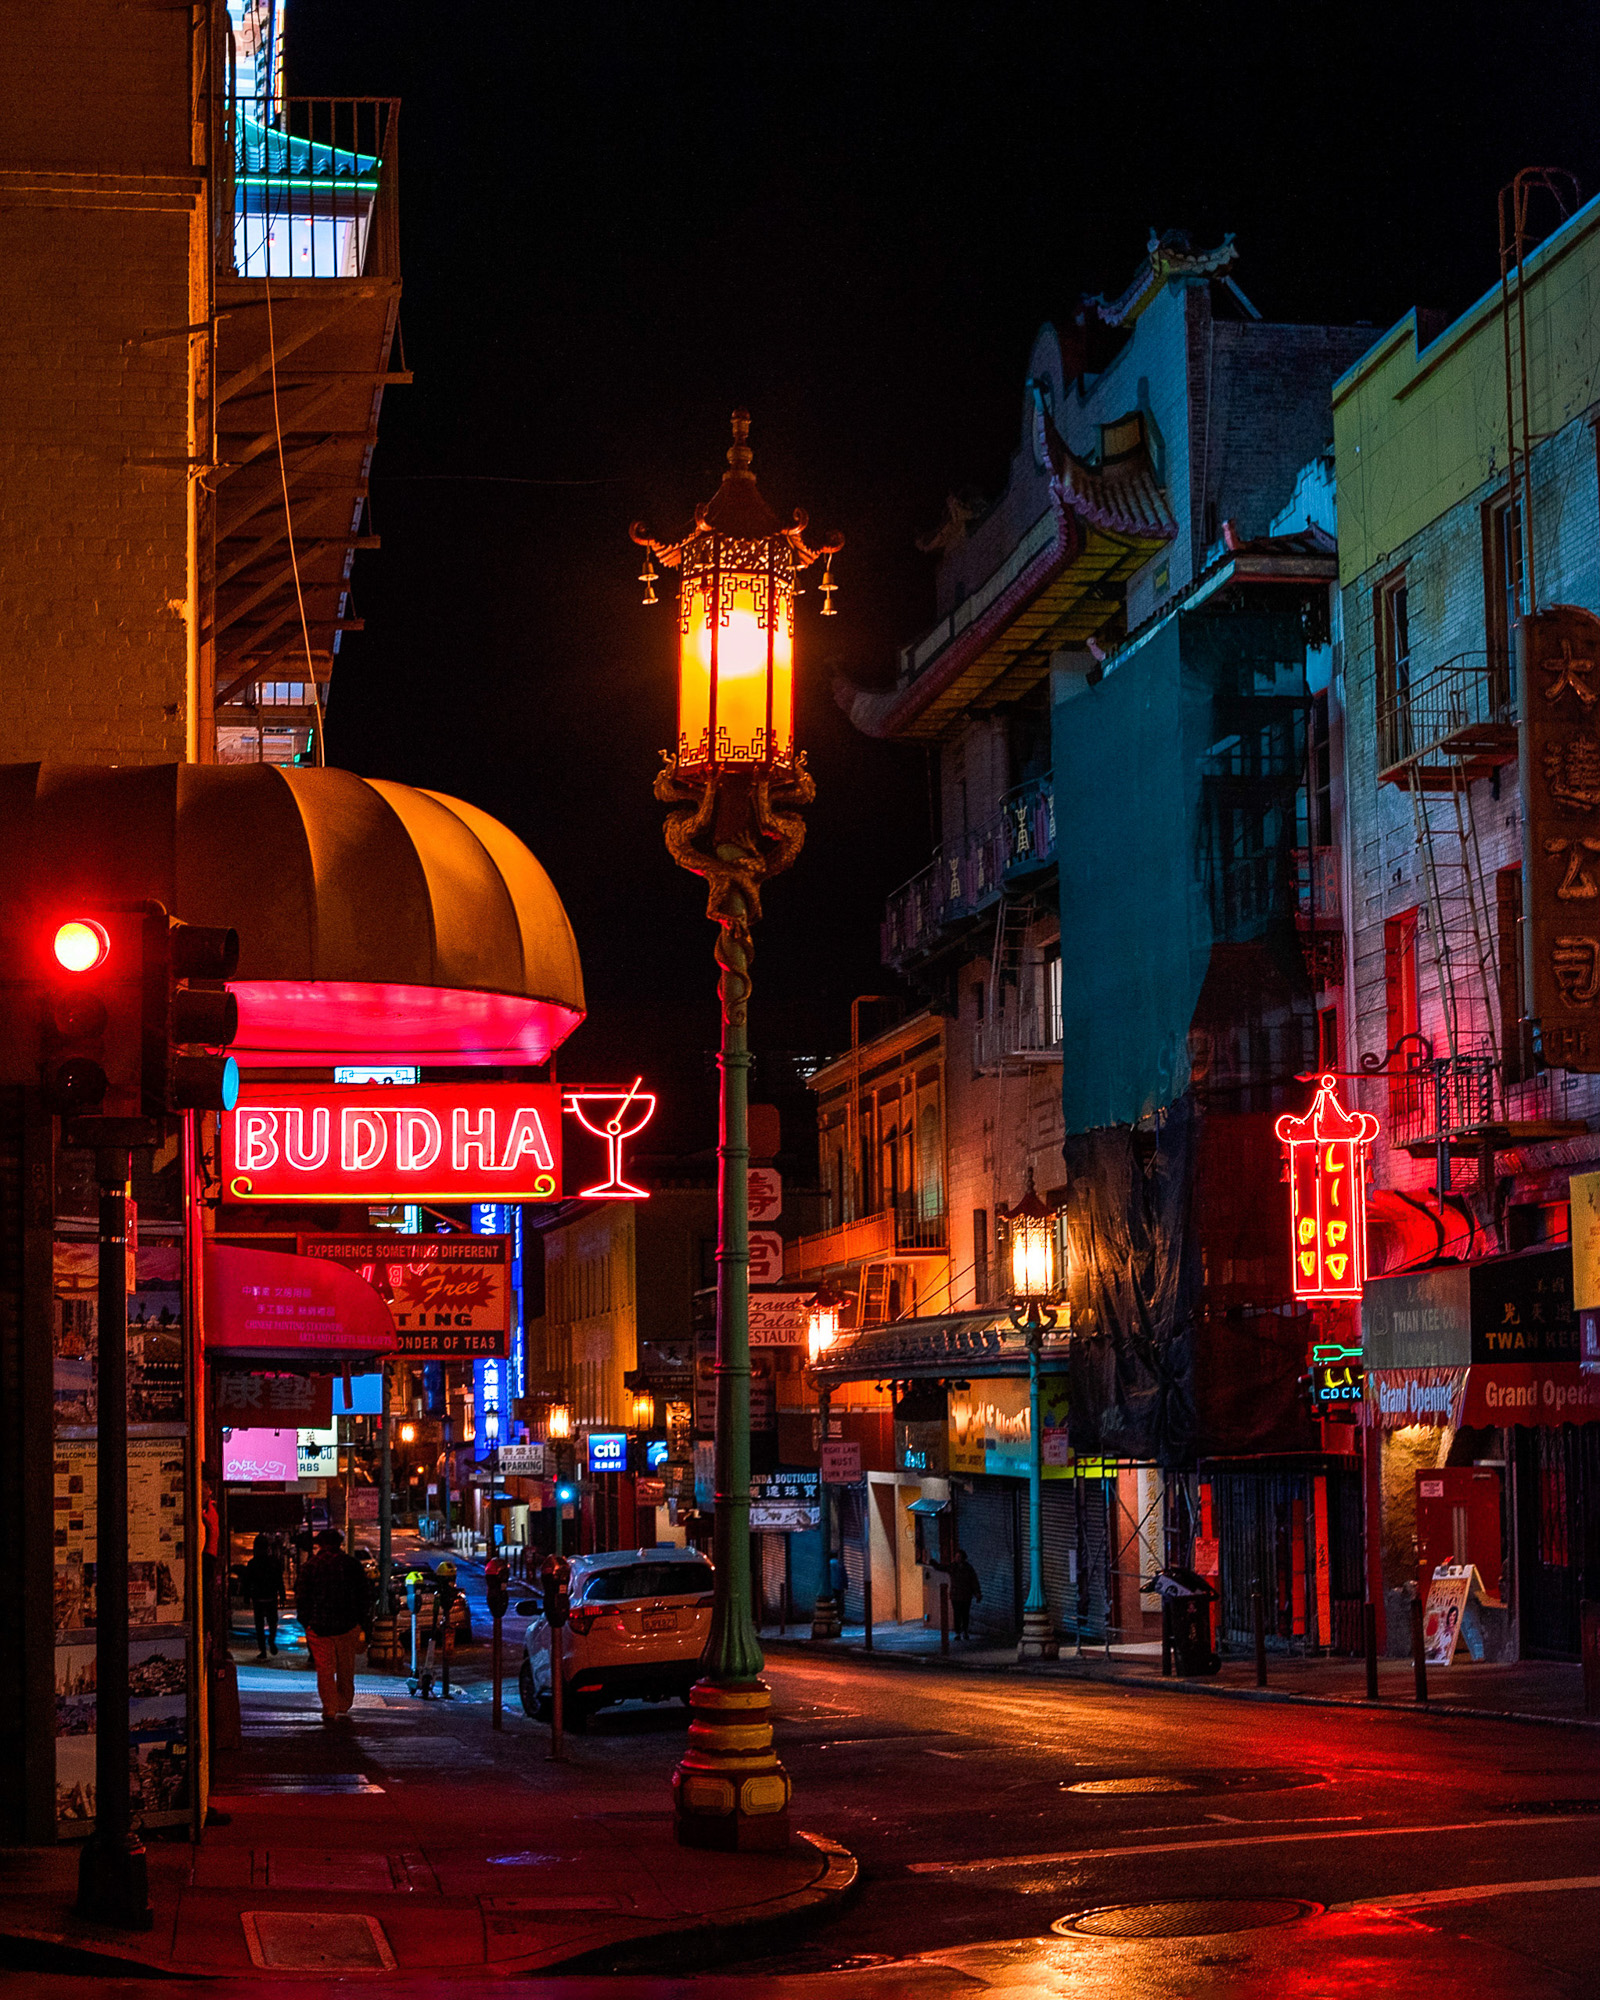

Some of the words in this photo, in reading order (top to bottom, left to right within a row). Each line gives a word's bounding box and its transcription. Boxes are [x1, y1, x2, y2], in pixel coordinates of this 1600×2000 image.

[234, 1106, 555, 1171] BUDDHA
[307, 1245, 372, 1257] EXPERIENCE
[376, 1245, 437, 1257] SOMETHING
[441, 1245, 498, 1258] DIFFERENT
[421, 1274, 479, 1301] Free
[1393, 1310, 1420, 1332] TWAN
[1421, 1308, 1440, 1331] KEE
[398, 1336, 438, 1349] ONDER
[443, 1336, 460, 1349] OF
[464, 1336, 496, 1349] TEAS
[749, 1330, 805, 1344] ESTAURA
[1485, 1332, 1538, 1350] TWAN
[1379, 1381, 1408, 1413] Grand
[1410, 1377, 1452, 1419] Opening
[1485, 1380, 1538, 1408] Grand
[56, 1451, 87, 1459] WELCOME
[88, 1451, 96, 1459] TO
[594, 1441, 621, 1458] citi
[507, 1461, 542, 1471] PARKING
[830, 1458, 853, 1466] MUST
[775, 1473, 819, 1483] BOUTIQUE
